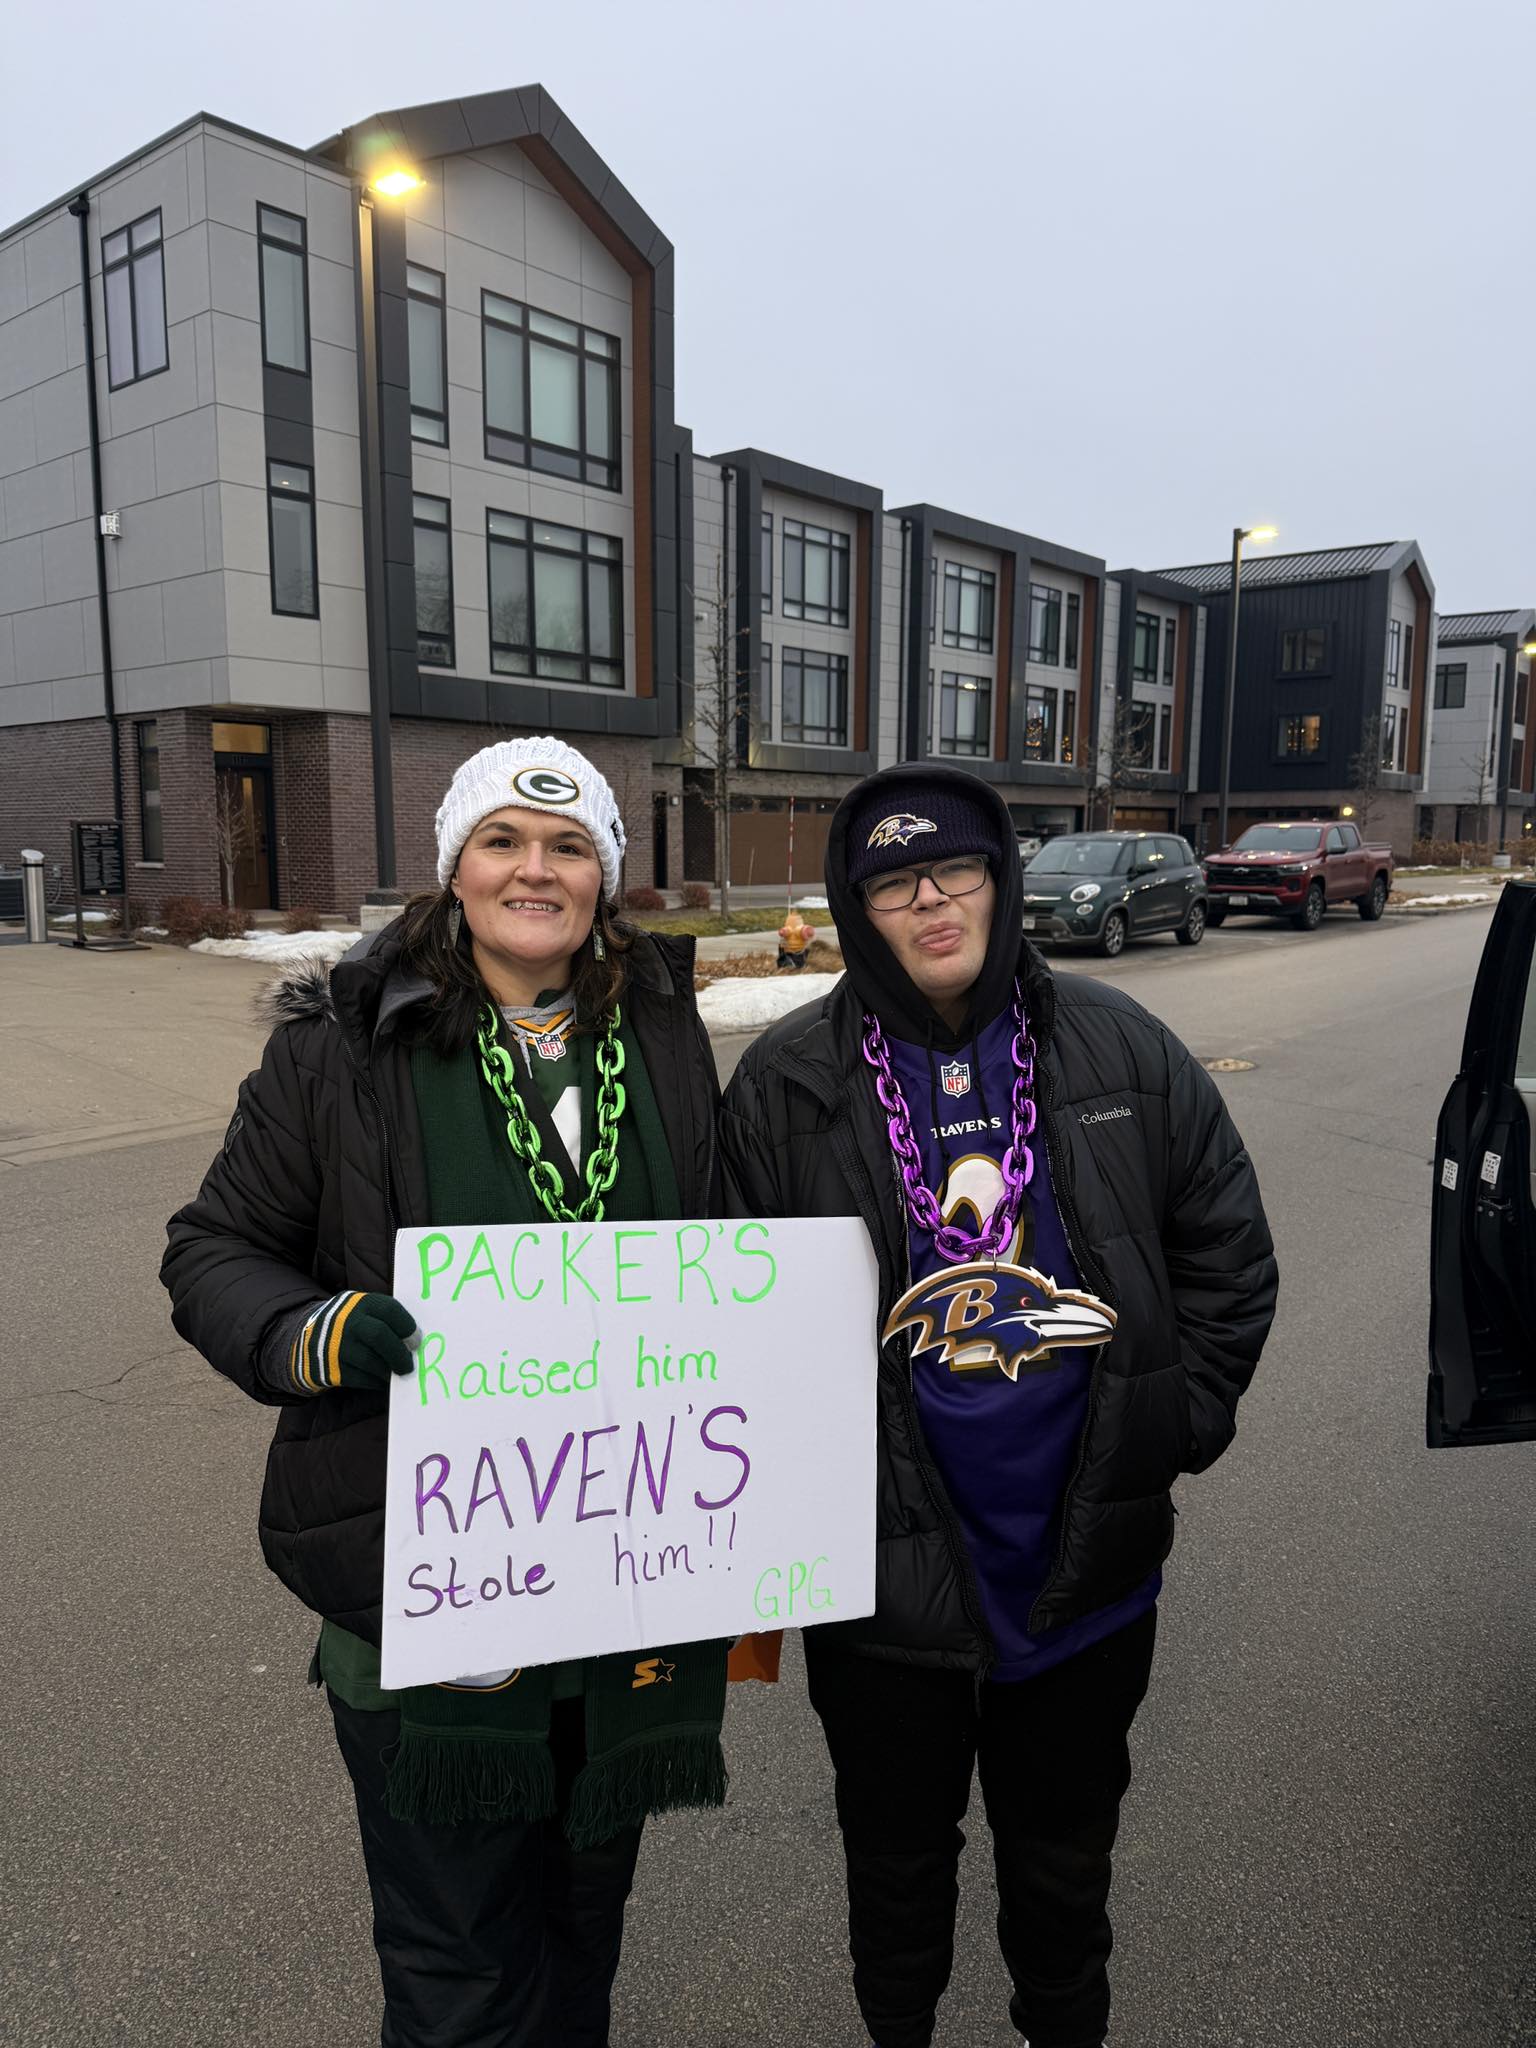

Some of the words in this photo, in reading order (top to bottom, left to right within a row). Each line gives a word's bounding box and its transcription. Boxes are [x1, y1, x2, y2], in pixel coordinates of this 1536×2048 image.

[539, 1041, 563, 1056] NFL
[946, 1076, 968, 1092] NFL
[1081, 1106, 1132, 1125] Columbia
[416, 1222, 778, 1305] PACKER'S
[415, 1331, 602, 1407] Raised
[635, 1335, 719, 1389] him
[414, 1403, 752, 1536] RAVEN'S
[614, 1511, 738, 1587] him!!
[753, 1556, 838, 1619] GPG
